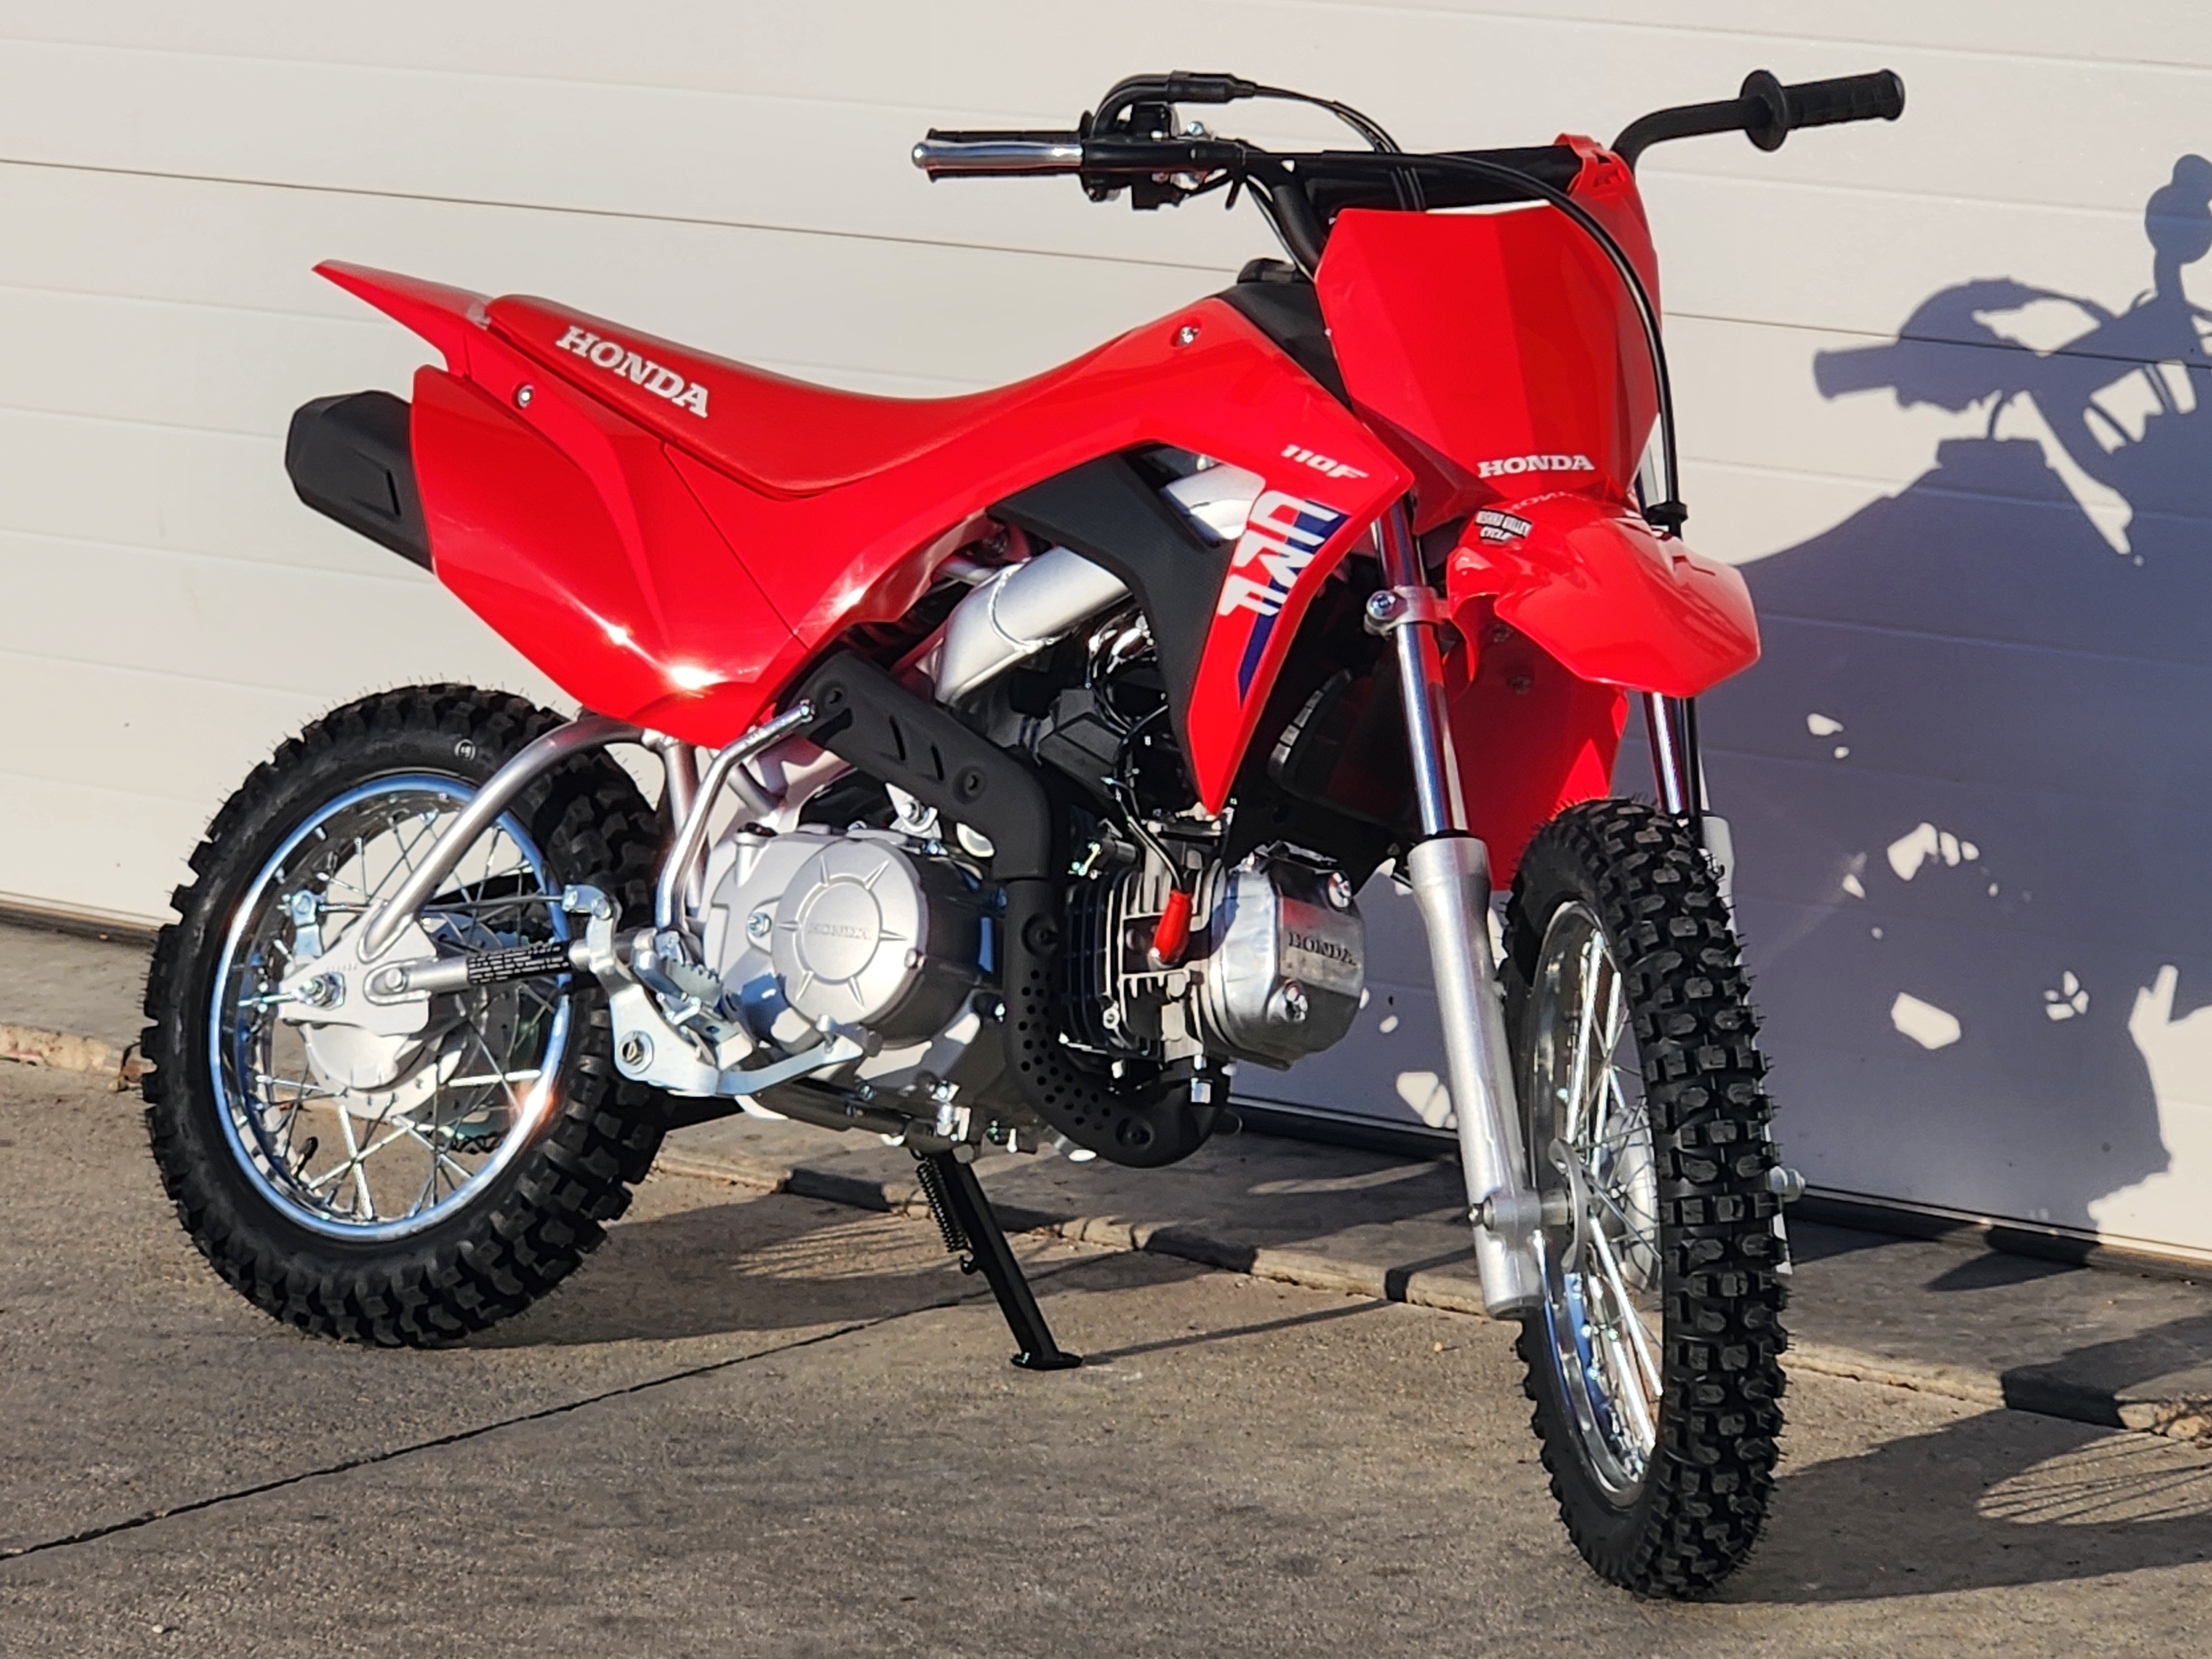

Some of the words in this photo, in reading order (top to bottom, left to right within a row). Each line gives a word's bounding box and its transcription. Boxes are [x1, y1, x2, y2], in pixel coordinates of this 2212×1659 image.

[556, 325, 708, 418] HONDA
[1281, 444, 1369, 478] 110F
[1478, 454, 1595, 478] HONDA
[1218, 490, 1338, 616] CRF
[1288, 931, 1357, 966] HONDA
